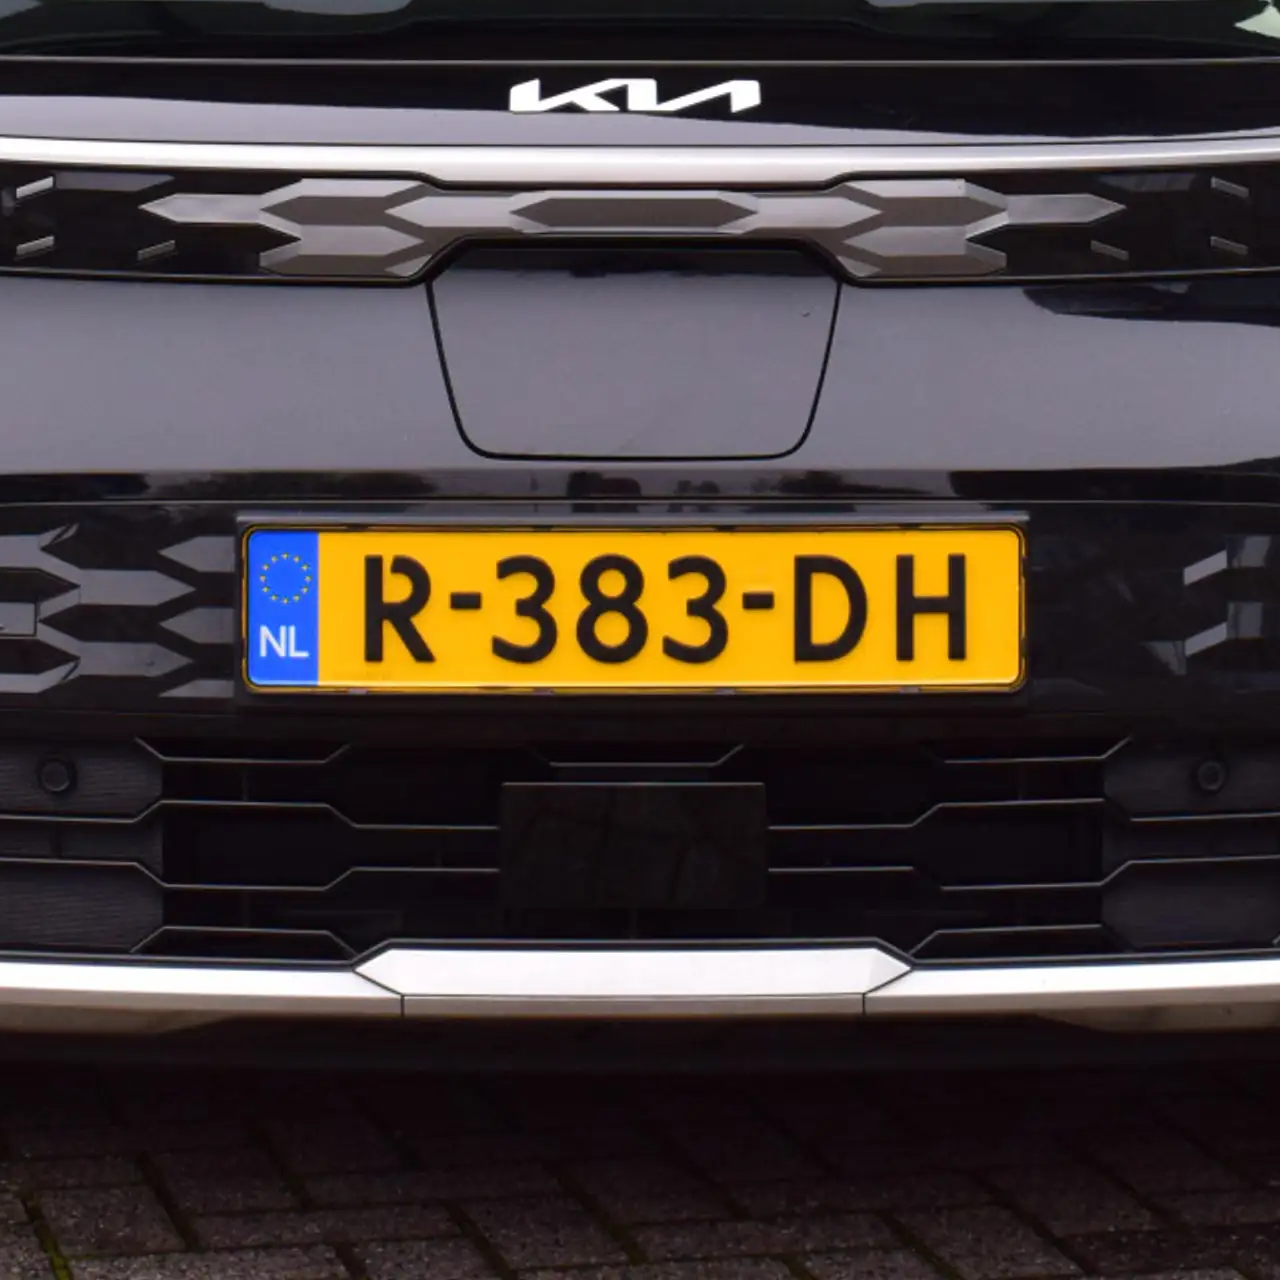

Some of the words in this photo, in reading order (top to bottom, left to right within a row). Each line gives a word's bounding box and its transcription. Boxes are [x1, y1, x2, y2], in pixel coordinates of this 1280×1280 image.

[509, 78, 761, 113] KIA
[364, 554, 967, 664] R-383-DH
[259, 625, 308, 658] NL
